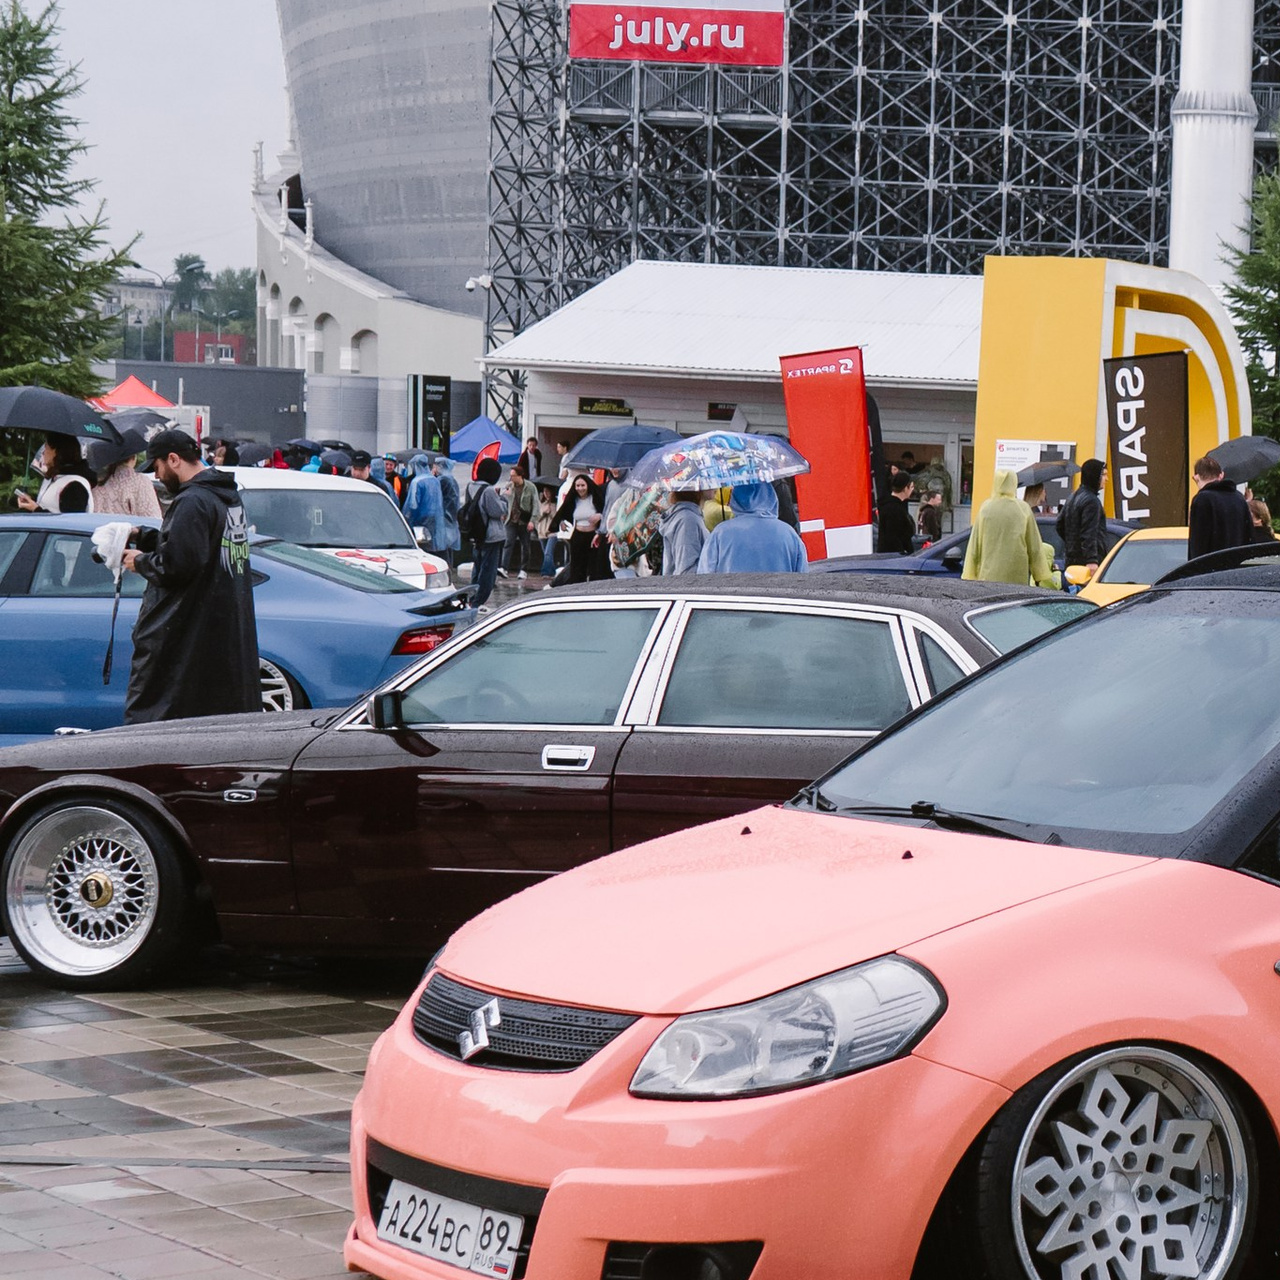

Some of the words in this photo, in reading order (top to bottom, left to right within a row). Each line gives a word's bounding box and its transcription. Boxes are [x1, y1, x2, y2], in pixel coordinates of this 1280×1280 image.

[608, 13, 745, 52] july.ru
[479, 1215, 511, 1255] 89
[473, 1251, 494, 1269] RUS
